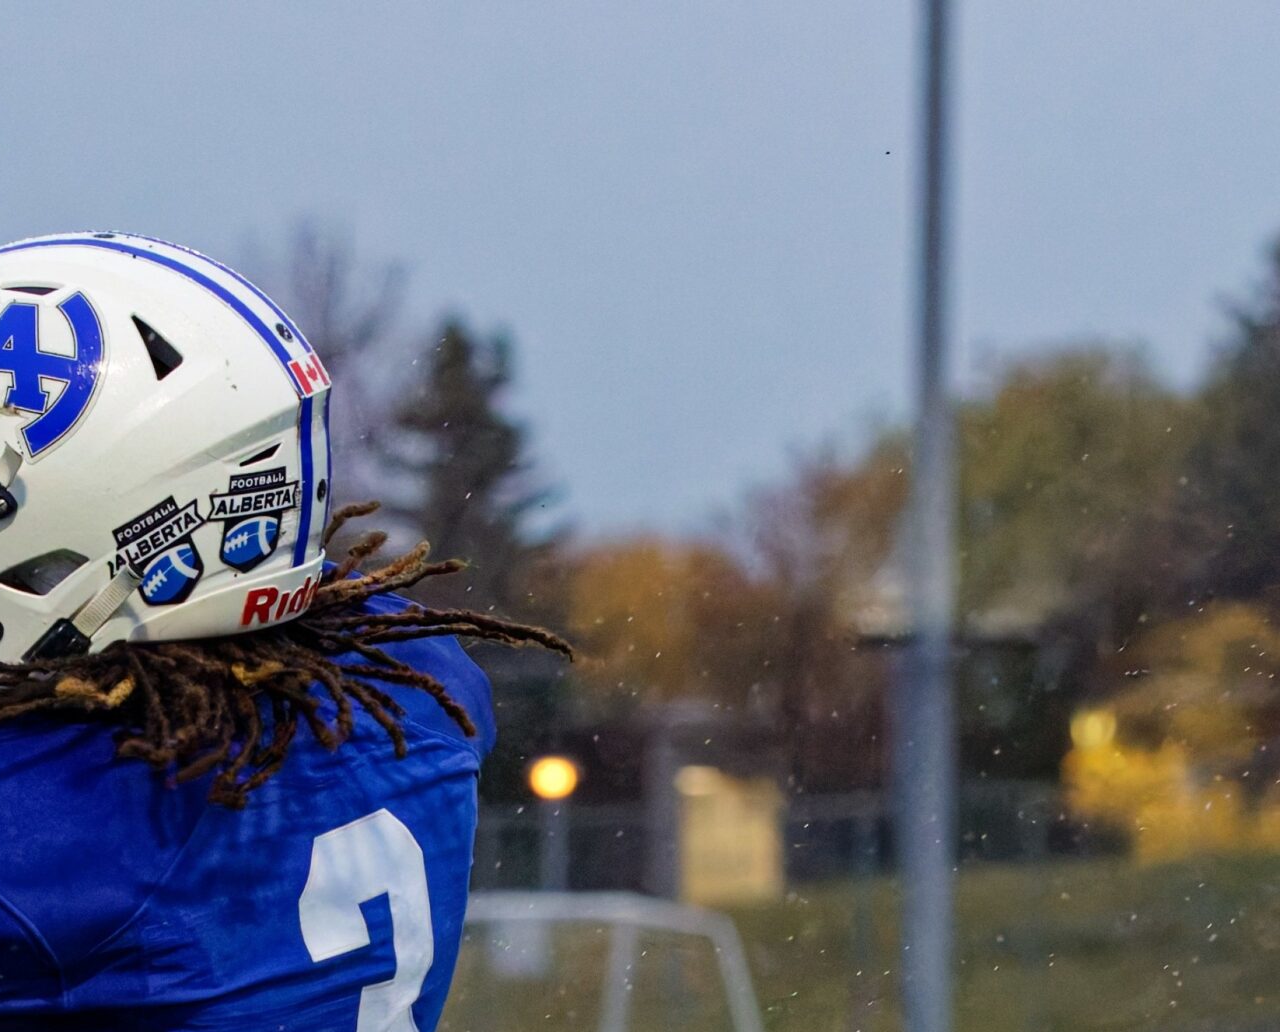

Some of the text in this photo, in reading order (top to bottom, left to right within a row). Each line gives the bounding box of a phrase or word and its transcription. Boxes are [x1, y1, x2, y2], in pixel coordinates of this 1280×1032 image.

[230, 472, 285, 490] FOOTBALL
[214, 488, 292, 516] ALBERTA
[116, 503, 176, 542] FOOTBALL
[115, 512, 197, 571] ALBERTA
